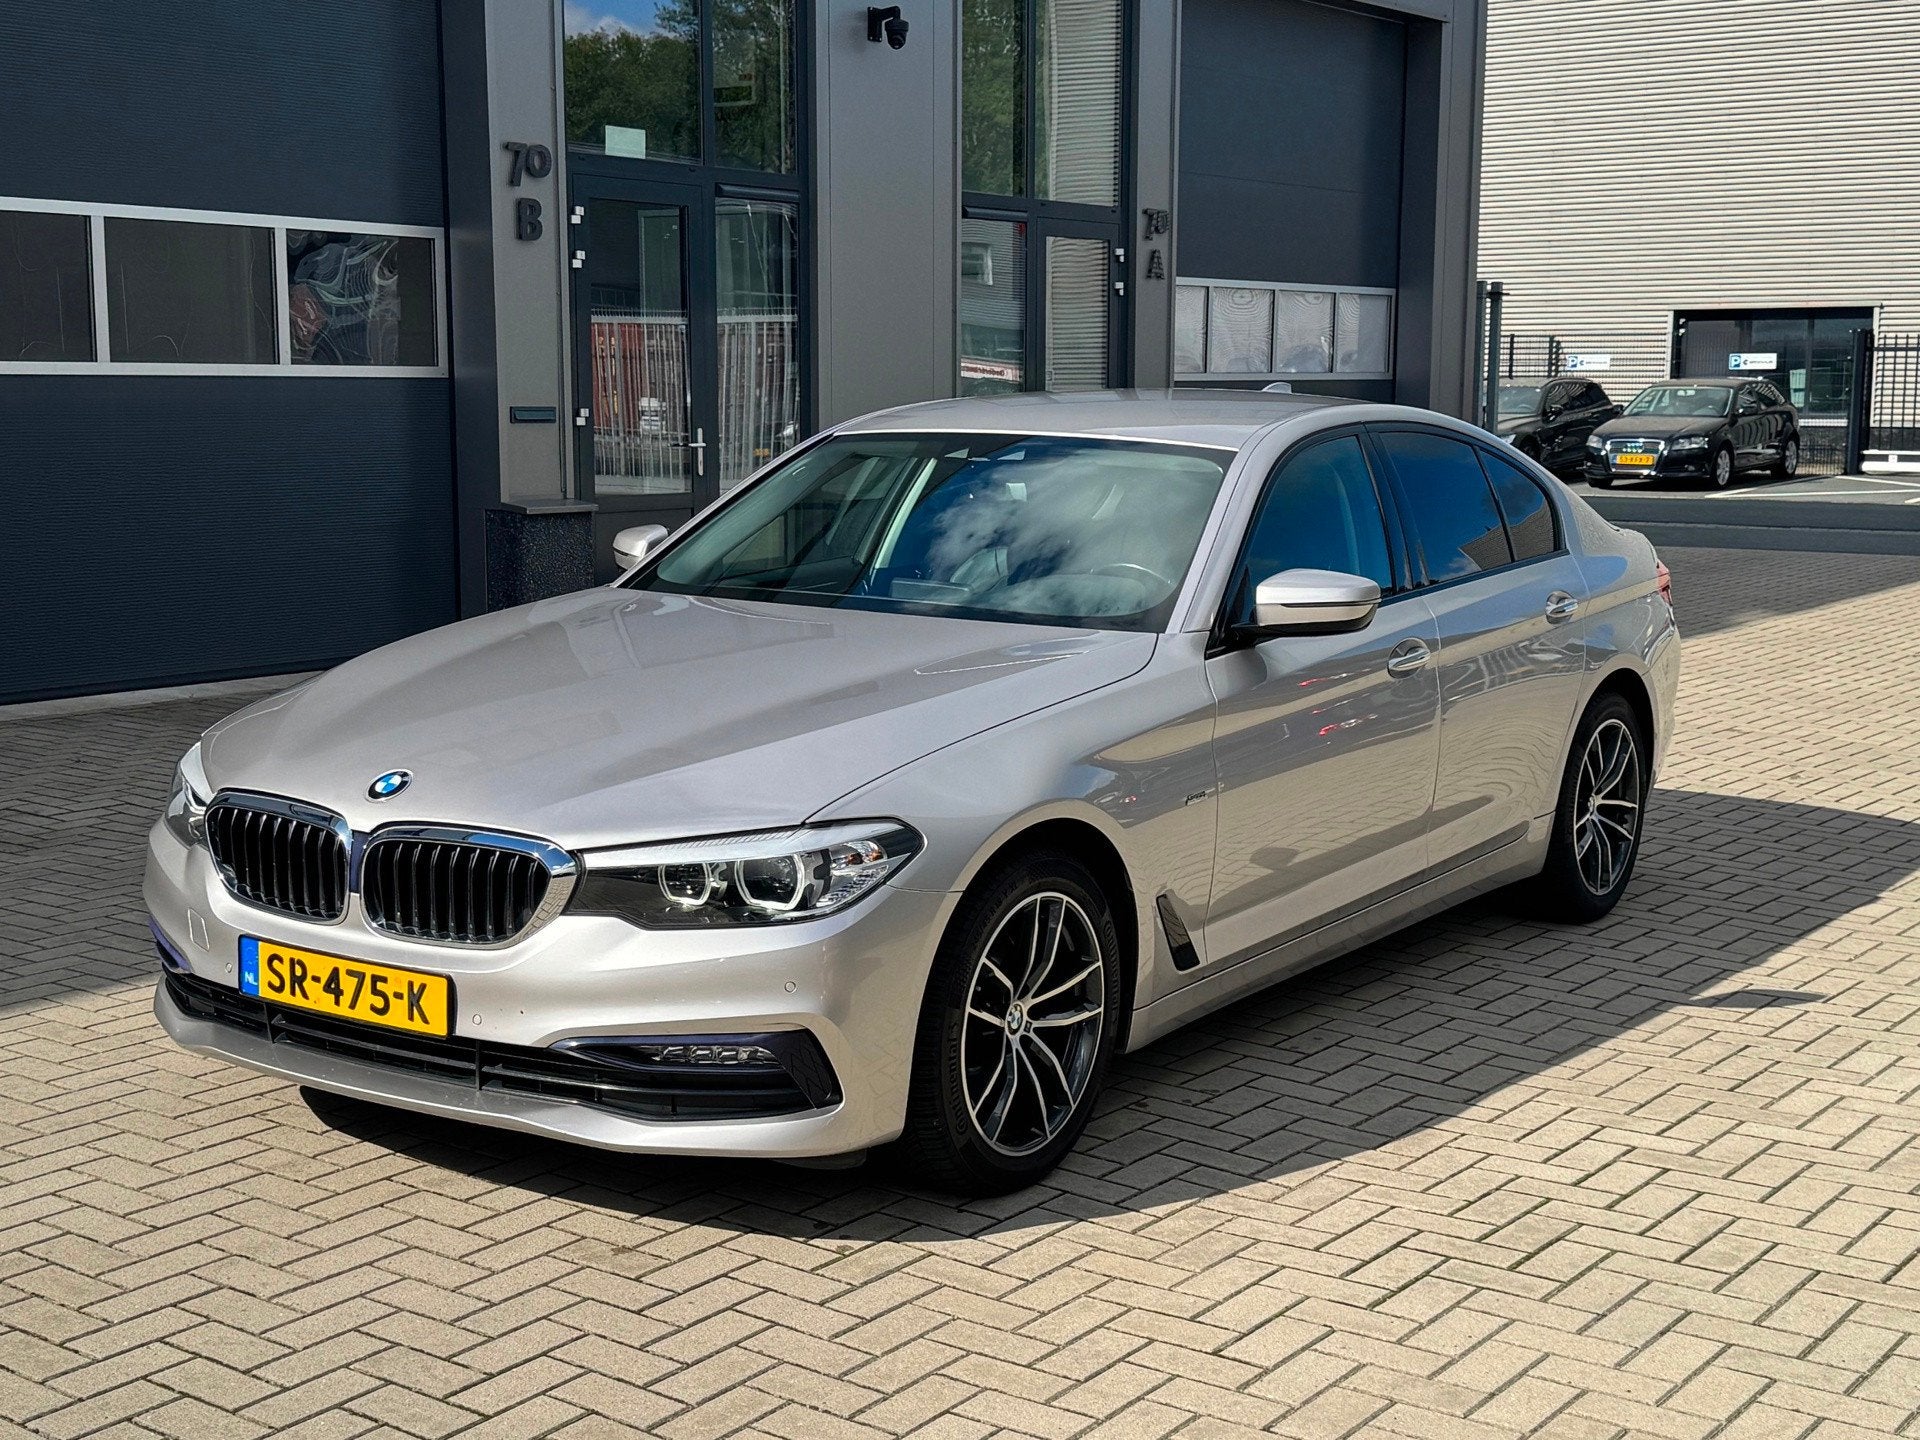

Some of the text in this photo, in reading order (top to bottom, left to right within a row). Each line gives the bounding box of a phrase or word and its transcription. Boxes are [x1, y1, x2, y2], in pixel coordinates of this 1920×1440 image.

[502, 142, 552, 187] 70
[515, 198, 543, 241] B
[1142, 208, 1169, 241] 70
[1146, 249, 1165, 280] A
[244, 971, 258, 986] NL
[266, 953, 430, 1025] SR-475-K
